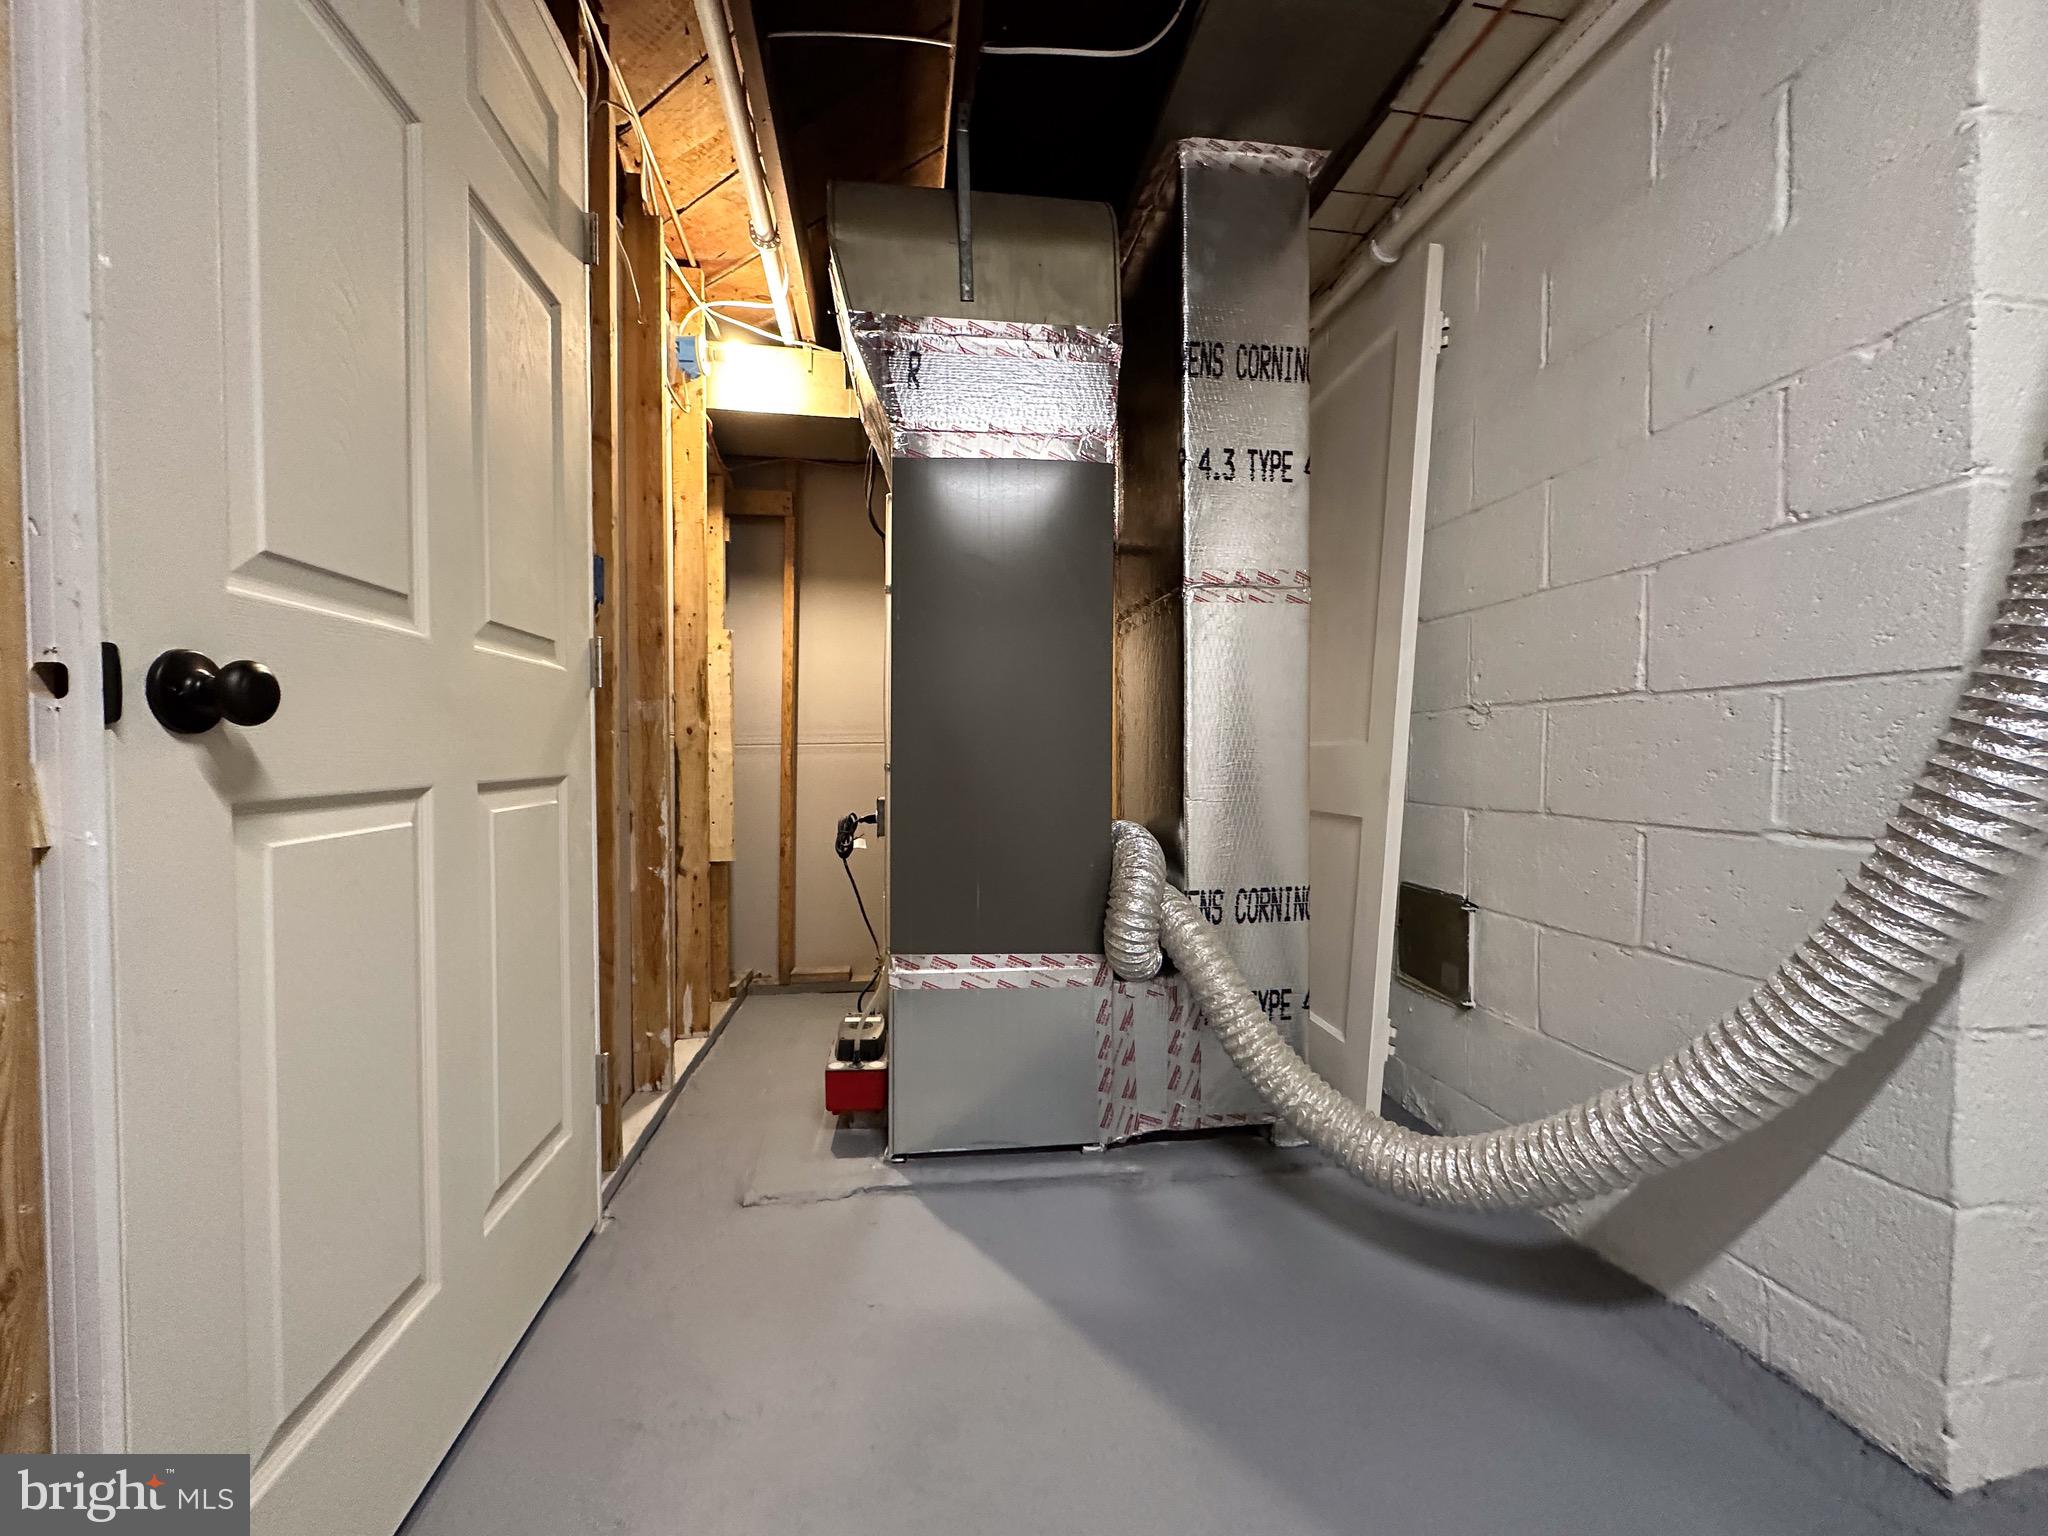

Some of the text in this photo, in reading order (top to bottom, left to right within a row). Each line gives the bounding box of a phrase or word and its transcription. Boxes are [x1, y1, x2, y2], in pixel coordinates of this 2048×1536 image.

[907, 350, 922, 390] R
[1198, 447, 1236, 481] 4.3
[1247, 449, 1294, 483] TYPE
[1251, 988, 1292, 1021] YPE
